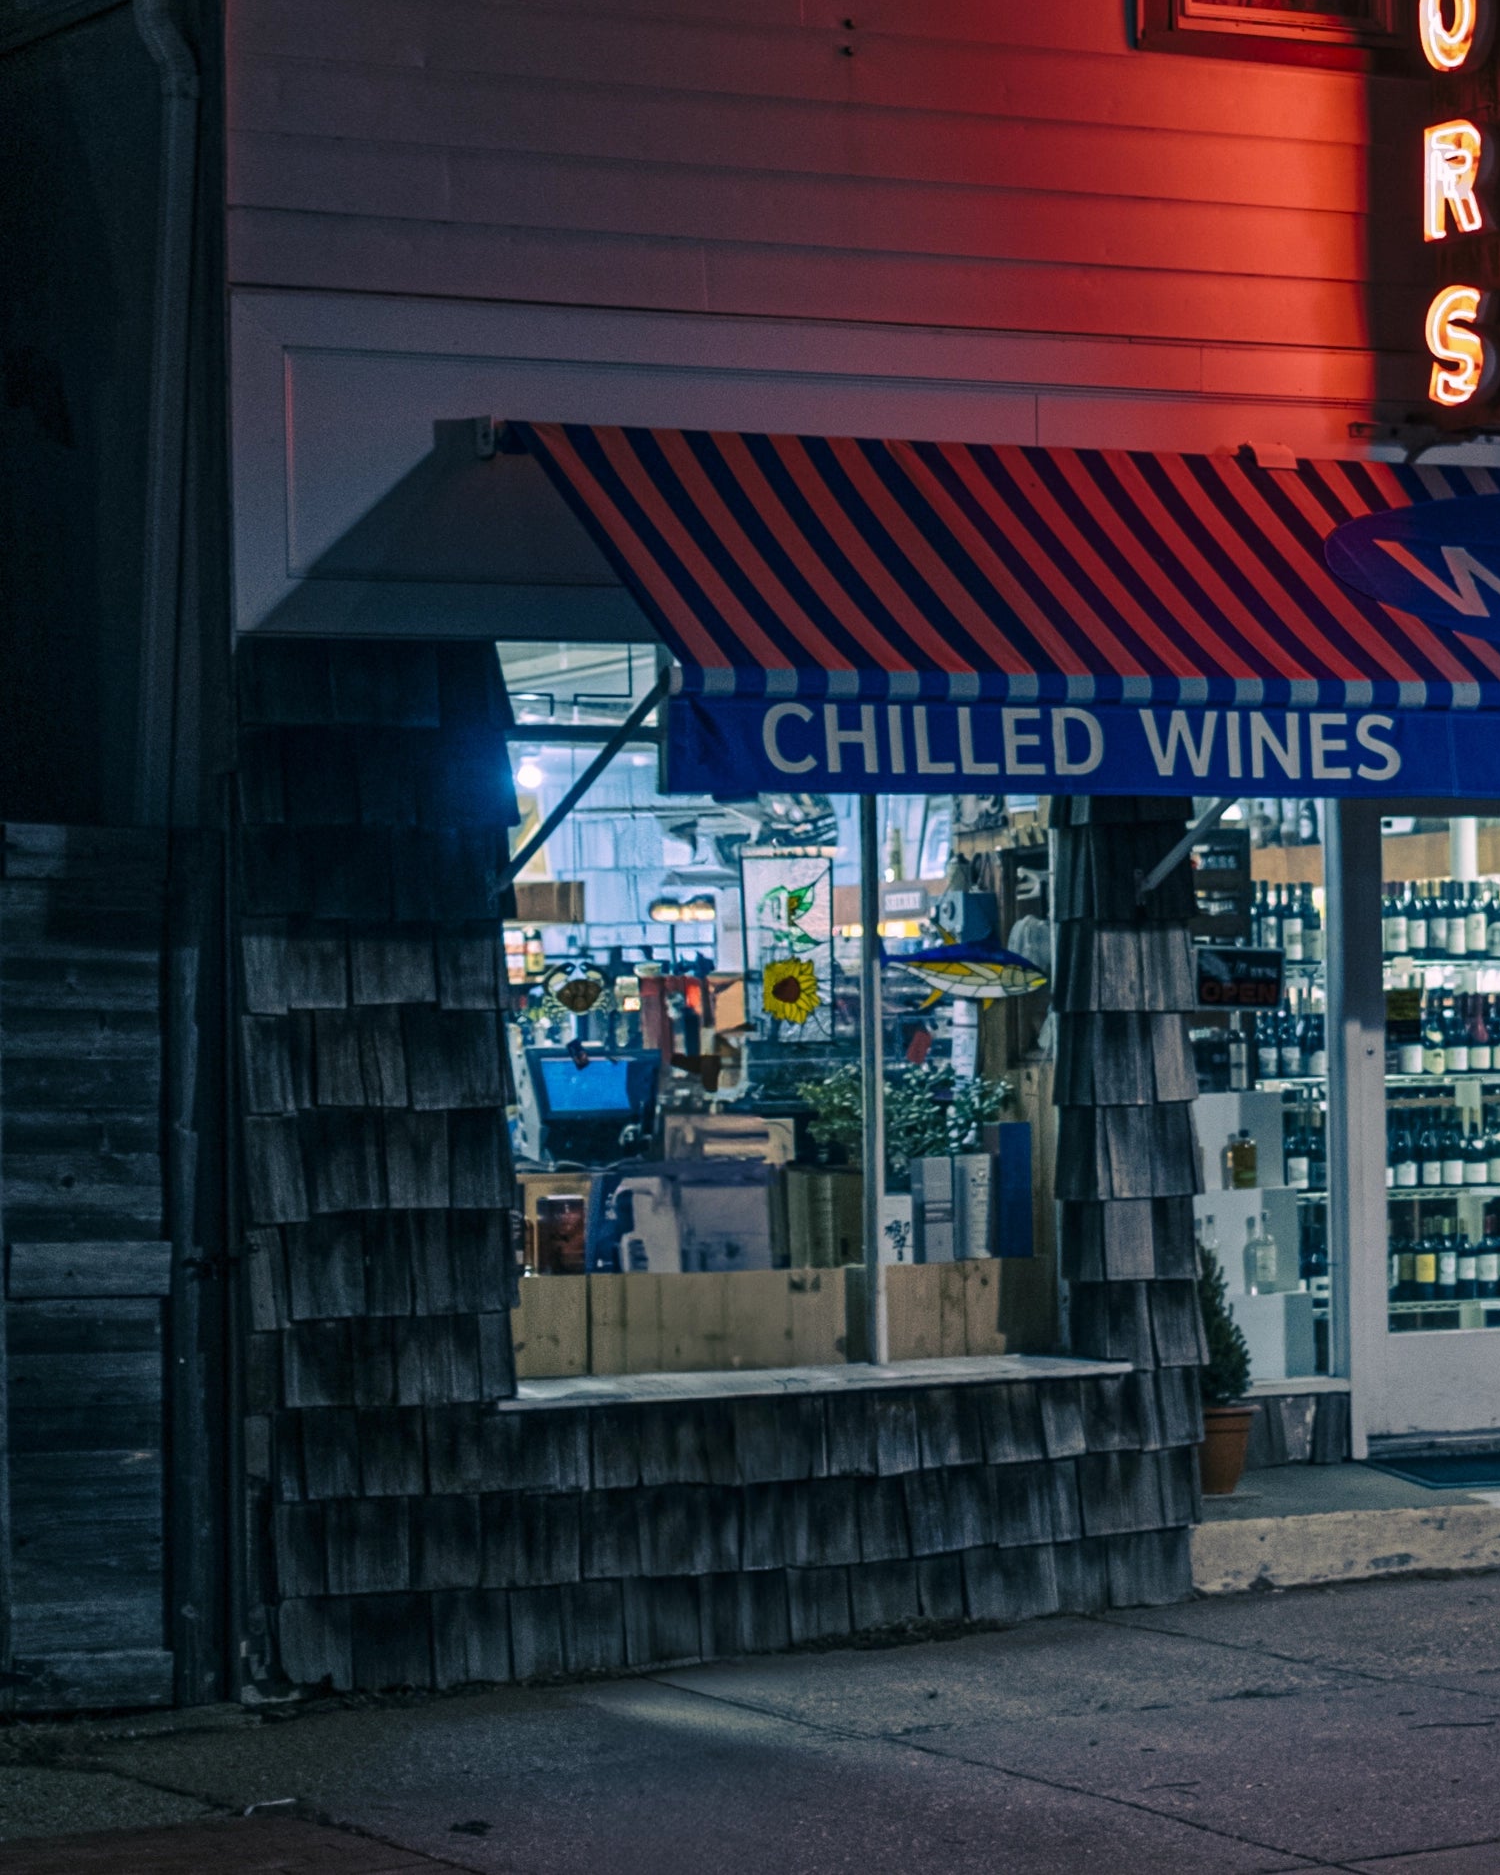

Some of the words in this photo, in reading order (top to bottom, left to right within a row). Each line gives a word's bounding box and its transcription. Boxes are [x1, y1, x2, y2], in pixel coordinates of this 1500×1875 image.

[762, 702, 1103, 776] CHILLED
[1139, 708, 1401, 780] WINES
[1202, 981, 1277, 1003] OPEN
